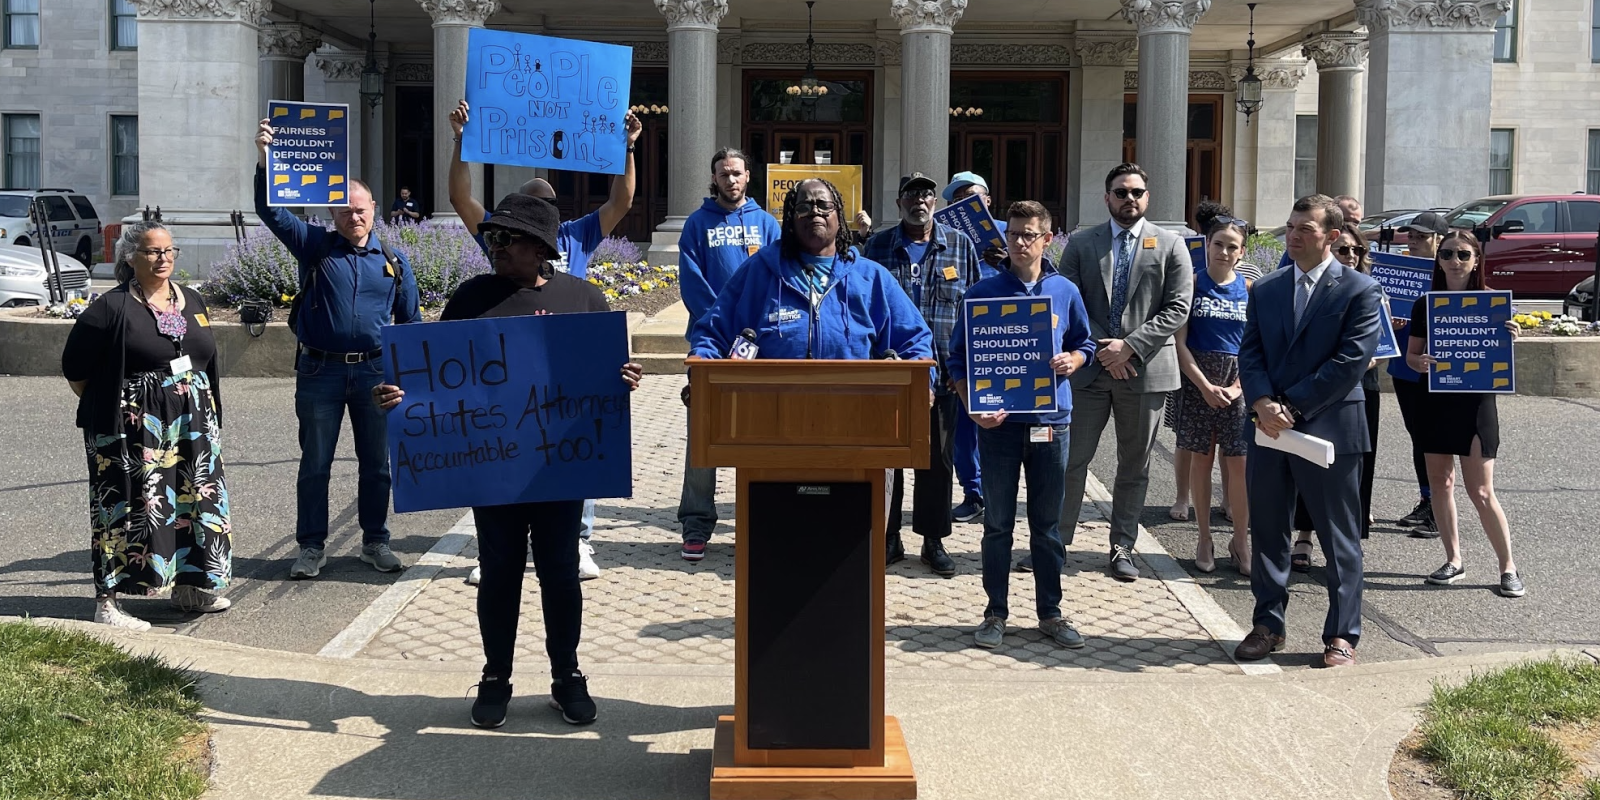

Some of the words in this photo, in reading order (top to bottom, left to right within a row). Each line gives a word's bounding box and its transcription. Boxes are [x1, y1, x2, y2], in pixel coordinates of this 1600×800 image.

[528, 100, 570, 119] NOT
[272, 126, 326, 136] FAIRNESS
[272, 138, 334, 148] SHOULDN'T
[272, 151, 318, 160] DEPEND
[319, 152, 336, 160] ON
[272, 163, 291, 171] ZIP
[292, 163, 323, 172] CODE
[957, 206, 981, 244] FAIRNESS
[708, 238, 726, 248] NOT
[1371, 266, 1432, 281] ACCOUNTABIL
[1371, 275, 1388, 284] FOR
[1389, 276, 1423, 289] STATE'S
[1381, 285, 1419, 297] TORNEYS
[1192, 297, 1247, 313] PEOPLE
[1192, 309, 1209, 318] NOT
[1433, 315, 1488, 324] FAIRNESS
[972, 325, 1029, 335] FAIRNESS
[1433, 327, 1498, 336] SHOULDN'T
[972, 338, 1039, 349] SHOULDN'T
[1434, 339, 1480, 347] DEPEND
[1482, 339, 1499, 347] ON
[973, 352, 1020, 362] DEPEND
[1023, 352, 1041, 361] ON
[1434, 351, 1452, 359] ZIP
[1454, 351, 1486, 359] CODE
[390, 332, 508, 392] Hold
[974, 367, 993, 376] ZIP
[994, 366, 1028, 375] CODE
[403, 398, 508, 438] States
[515, 383, 630, 430] Attorneys
[396, 436, 521, 487] Accountable
[535, 418, 605, 466] too!
